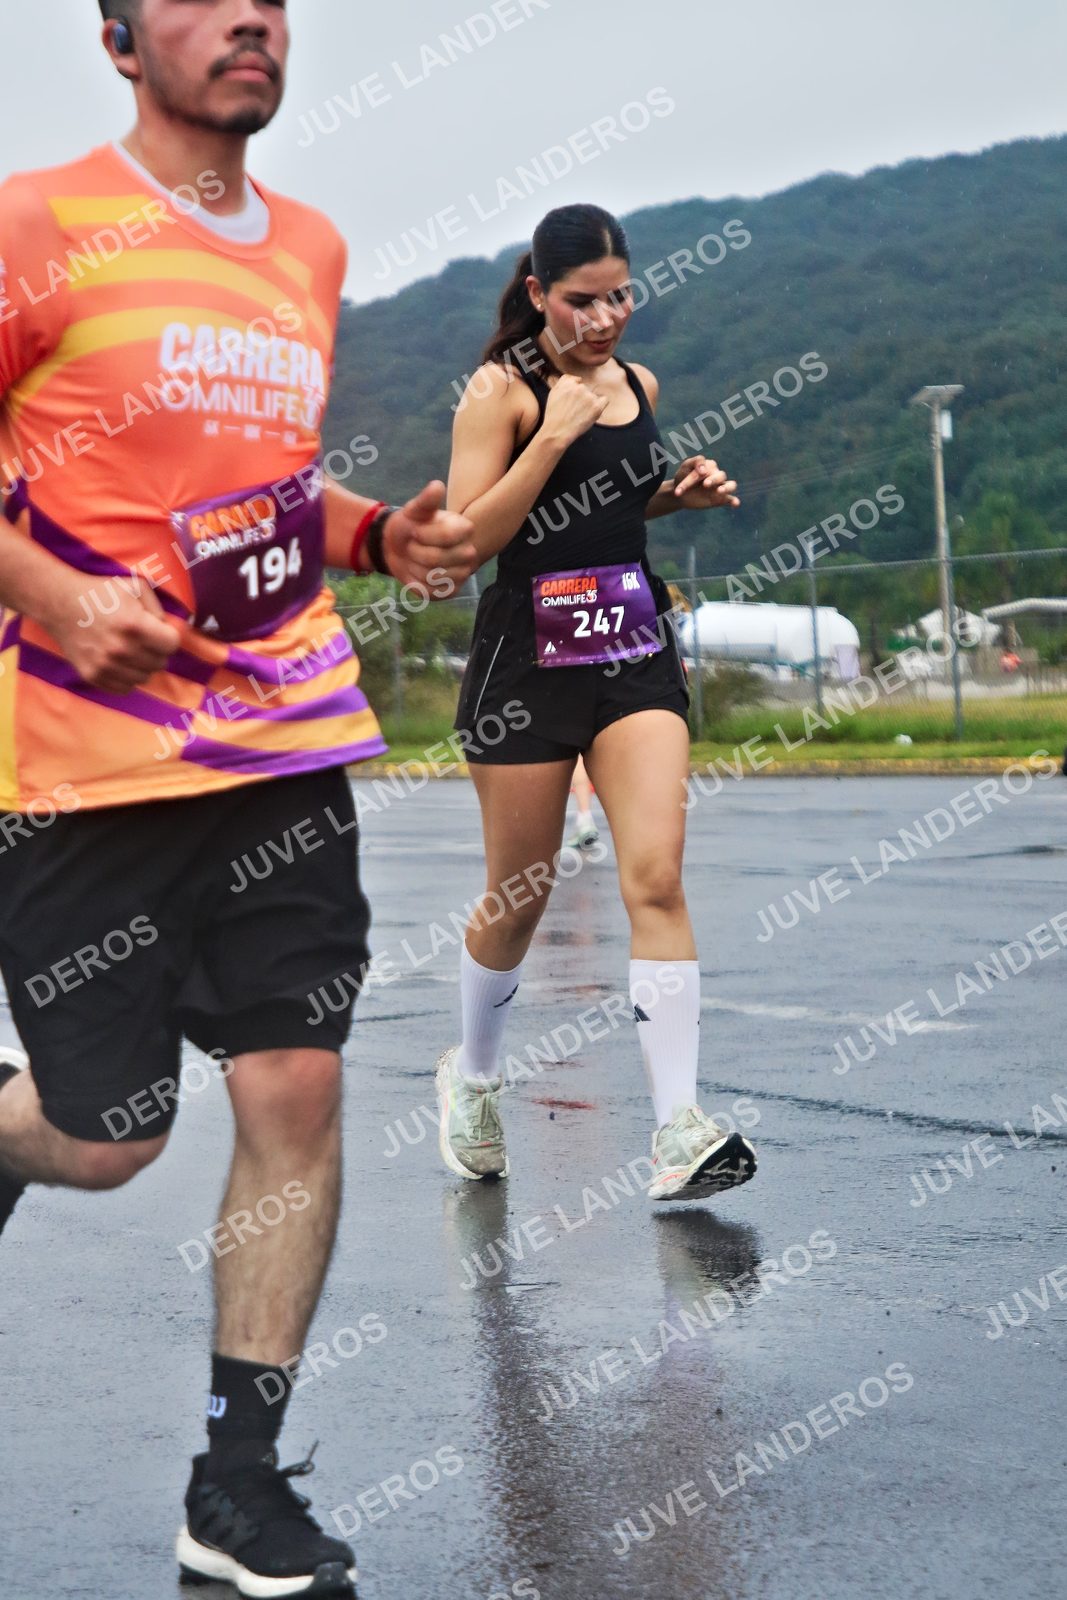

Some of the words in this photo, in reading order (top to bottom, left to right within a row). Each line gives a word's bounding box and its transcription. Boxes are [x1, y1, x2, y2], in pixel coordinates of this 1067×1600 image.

[238, 536, 302, 600] 194
[541, 577, 597, 596] CARRERA
[572, 605, 625, 638] 247
